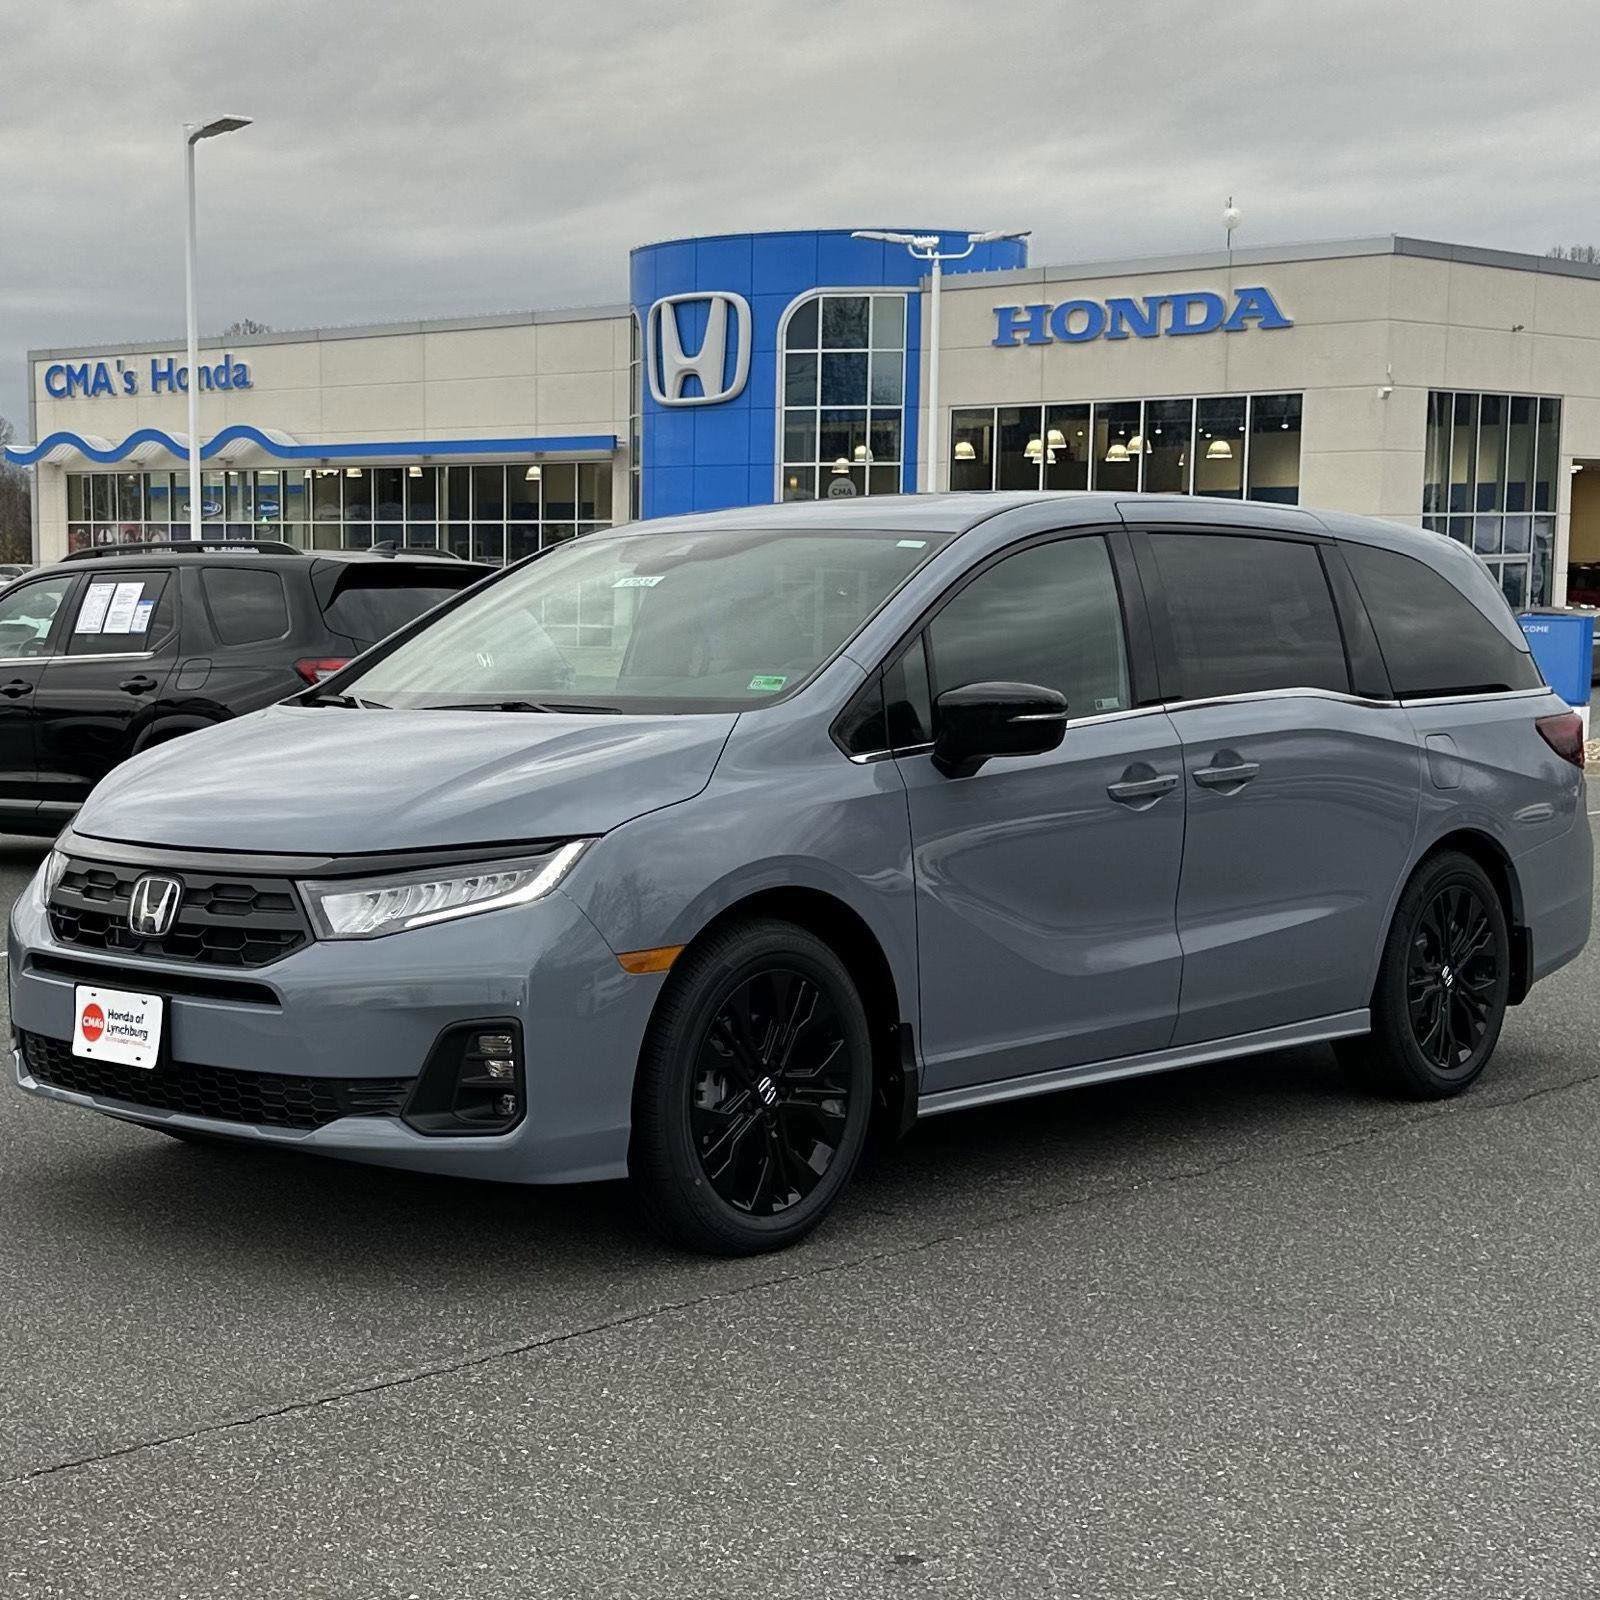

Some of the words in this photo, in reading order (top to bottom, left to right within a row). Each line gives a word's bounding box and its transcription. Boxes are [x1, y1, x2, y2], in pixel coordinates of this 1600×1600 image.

[992, 286, 1294, 348] HONDA
[45, 359, 138, 398] CMA's
[151, 353, 253, 393] Honda
[1522, 625, 1549, 633] COME
[107, 1009, 134, 1023] Honda
[135, 1013, 145, 1025] of
[107, 1021, 149, 1041] Lynchburg
